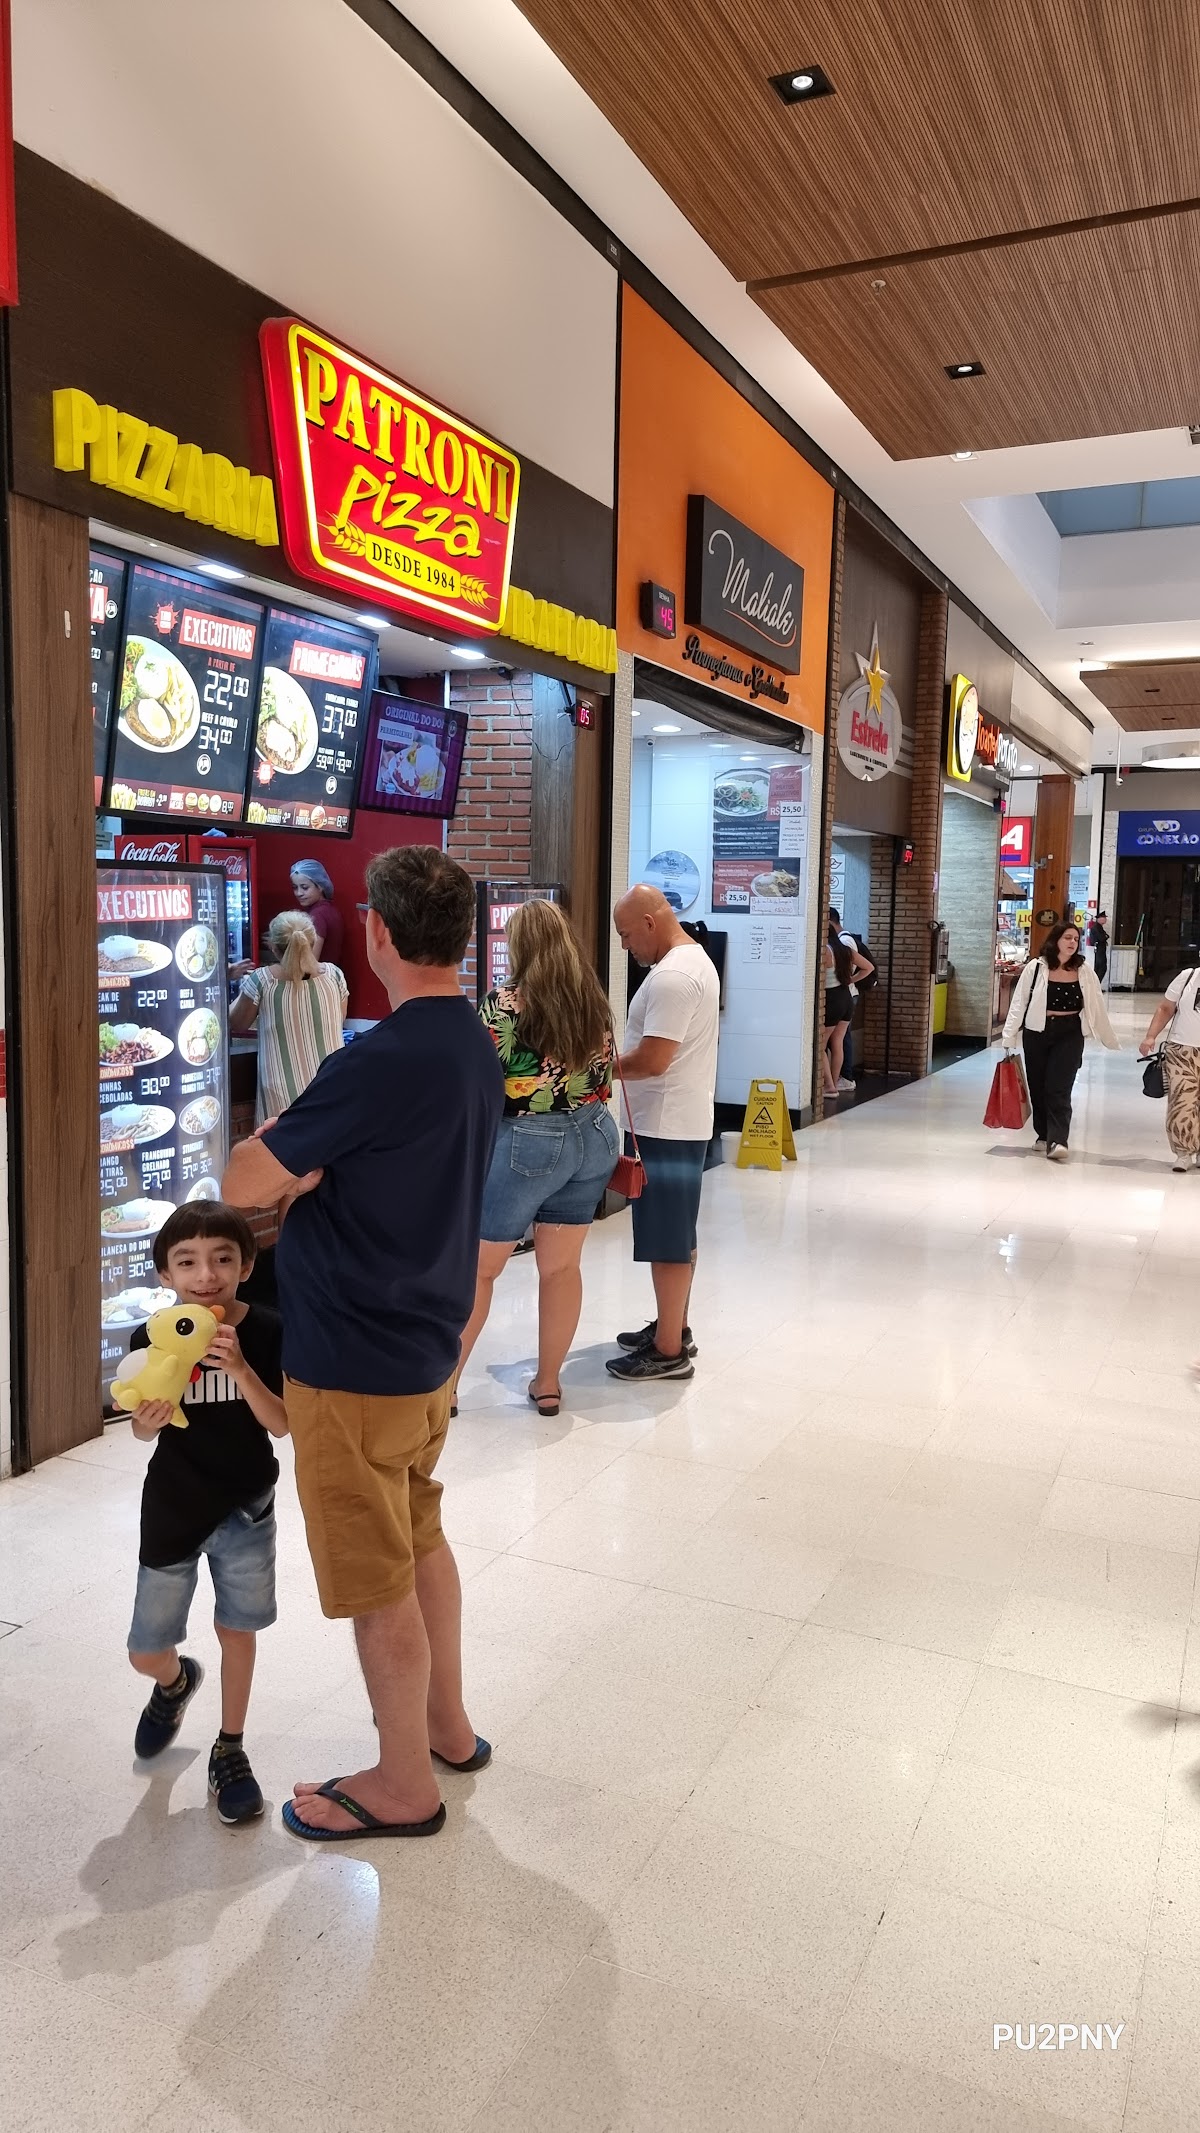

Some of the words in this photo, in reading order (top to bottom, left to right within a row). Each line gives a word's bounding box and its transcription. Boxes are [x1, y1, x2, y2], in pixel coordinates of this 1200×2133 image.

[303, 346, 511, 524] PATRONI
[53, 388, 279, 546] PIZZARIA
[372, 543, 421, 575] DESDE
[427, 561, 455, 592] 1984
[505, 585, 618, 674] TRATTORIA
[660, 607, 673, 631] 45
[184, 616, 252, 653] EXECUTIVOS
[204, 669, 250, 711] 22,00
[322, 705, 357, 739] 37,00
[385, 706, 420, 724] ORIGINAL
[420, 714, 430, 725] DO
[198, 725, 232, 755] 34,00
[851, 710, 888, 755] Estrela
[977, 711, 1000, 766] Toasted
[782, 806, 801, 814] 25,50
[1137, 833, 1200, 845] CONEXÃO
[112, 992, 120, 1001] DE
[137, 990, 168, 1008] 22,00
[141, 1076, 170, 1096] 30,00
[106, 1166, 123, 1177] TIRAS
[143, 1169, 171, 1190] 27,00
[128, 1253, 145, 1263] FRANGO
[129, 1242, 137, 1252] DO
[128, 1259, 154, 1278] 30,00
